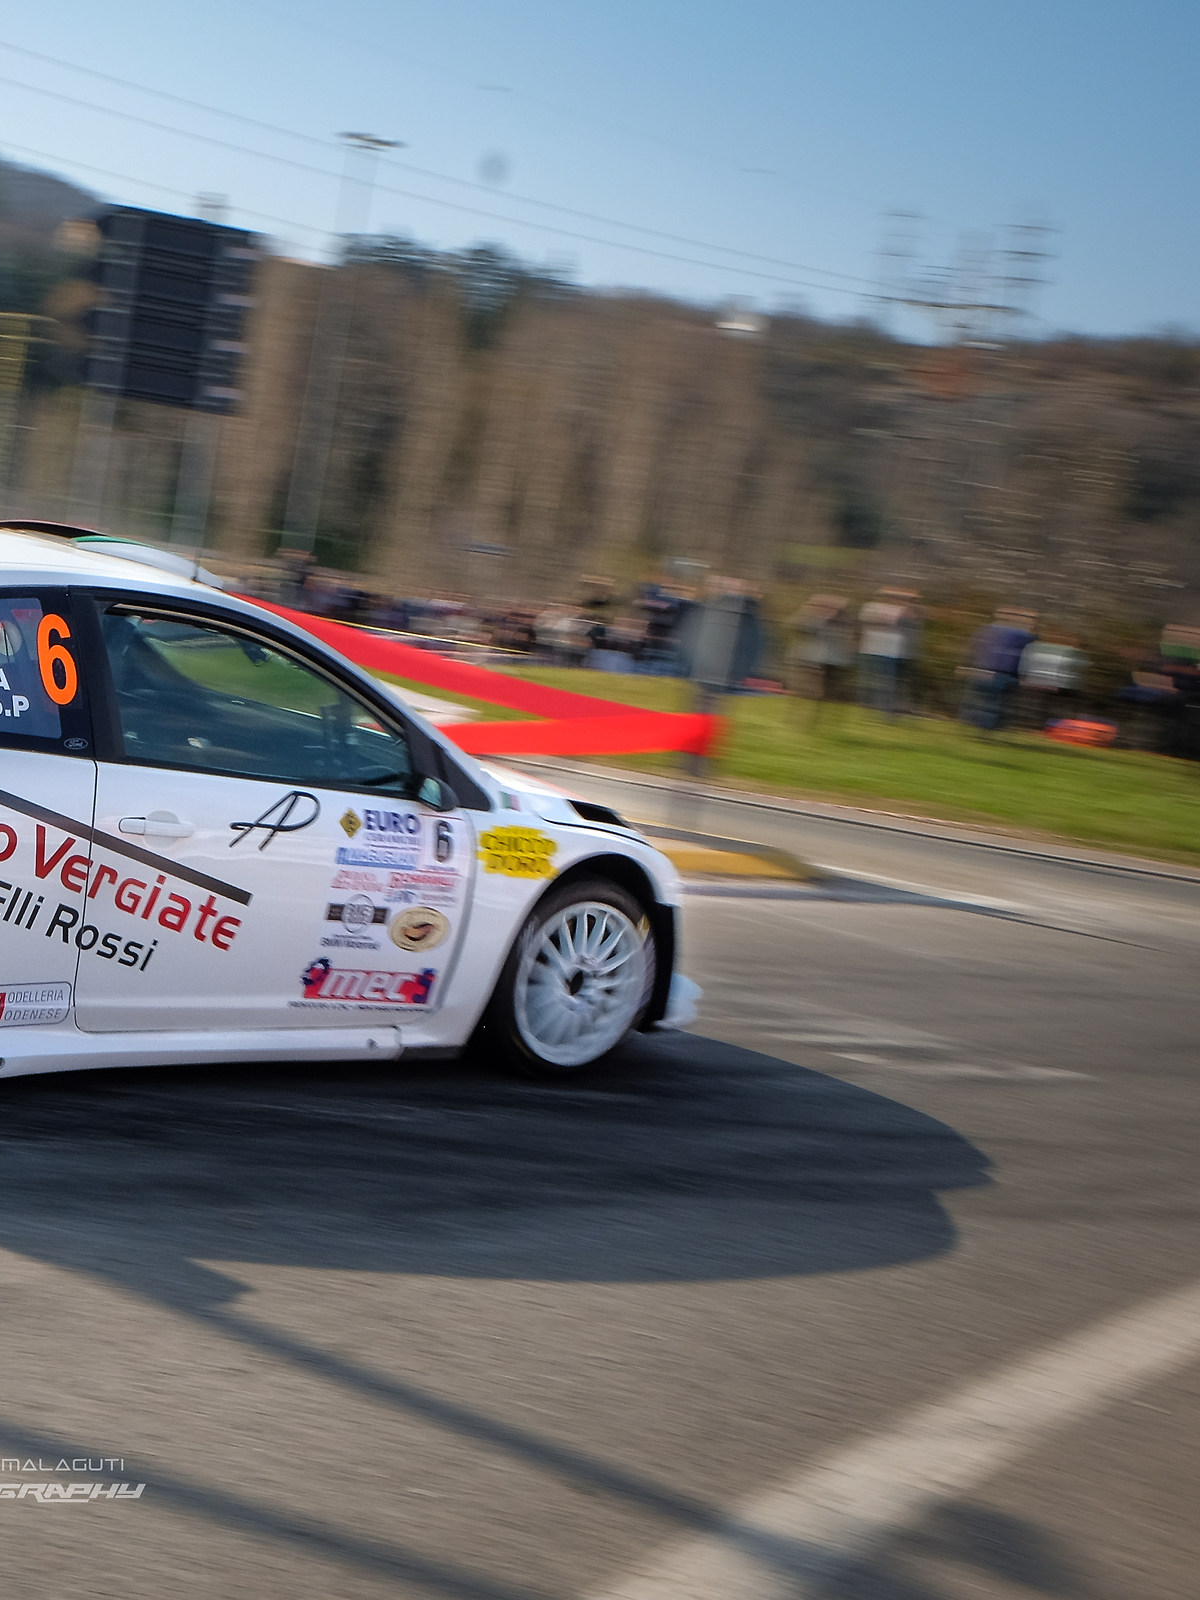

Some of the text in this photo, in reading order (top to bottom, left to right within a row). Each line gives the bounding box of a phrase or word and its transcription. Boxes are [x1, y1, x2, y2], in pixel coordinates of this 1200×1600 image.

[36, 613, 78, 706] 6
[363, 807, 421, 835] EURO
[434, 819, 454, 863] 6
[45, 902, 159, 972] Rossi
